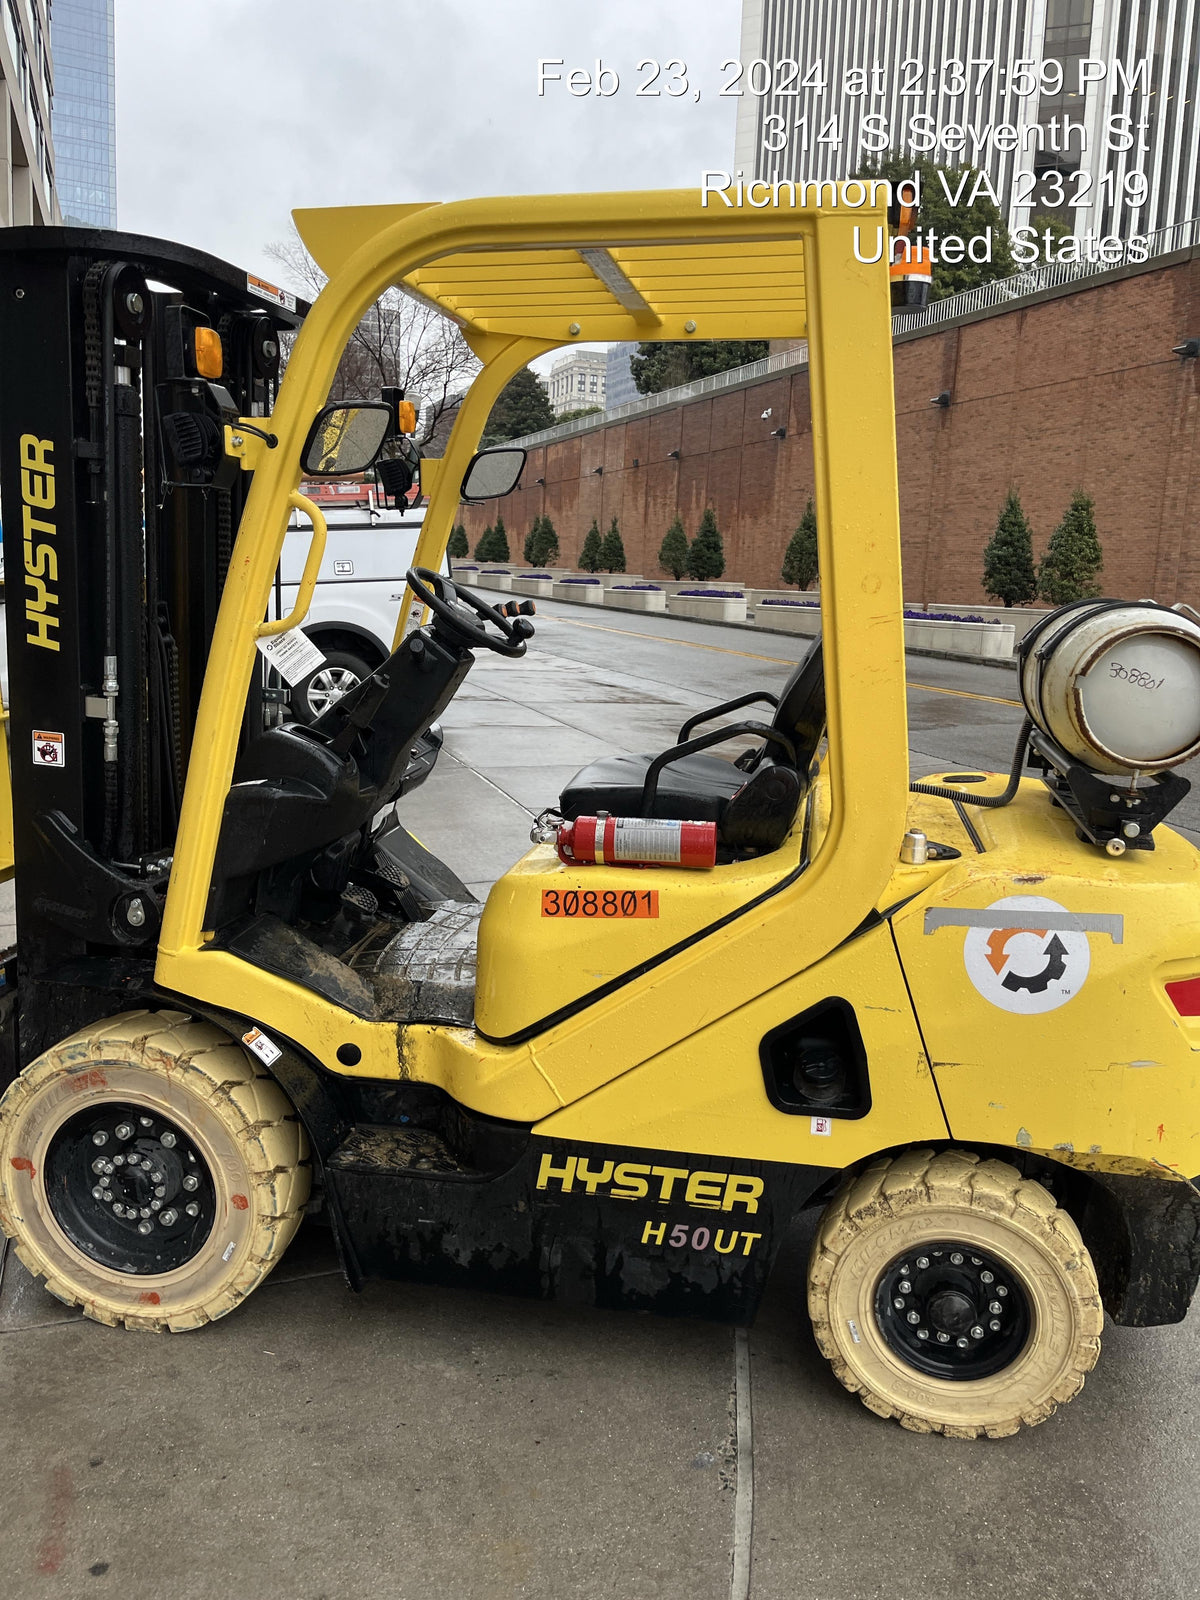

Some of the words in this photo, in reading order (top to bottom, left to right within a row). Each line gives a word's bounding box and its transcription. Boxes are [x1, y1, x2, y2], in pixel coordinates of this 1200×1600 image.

[20, 434, 60, 651] HYSTER
[1109, 662, 1165, 689] 308801
[544, 890, 651, 916] 308801
[536, 1153, 764, 1214] HYSTER
[641, 1221, 762, 1255] H50UT
